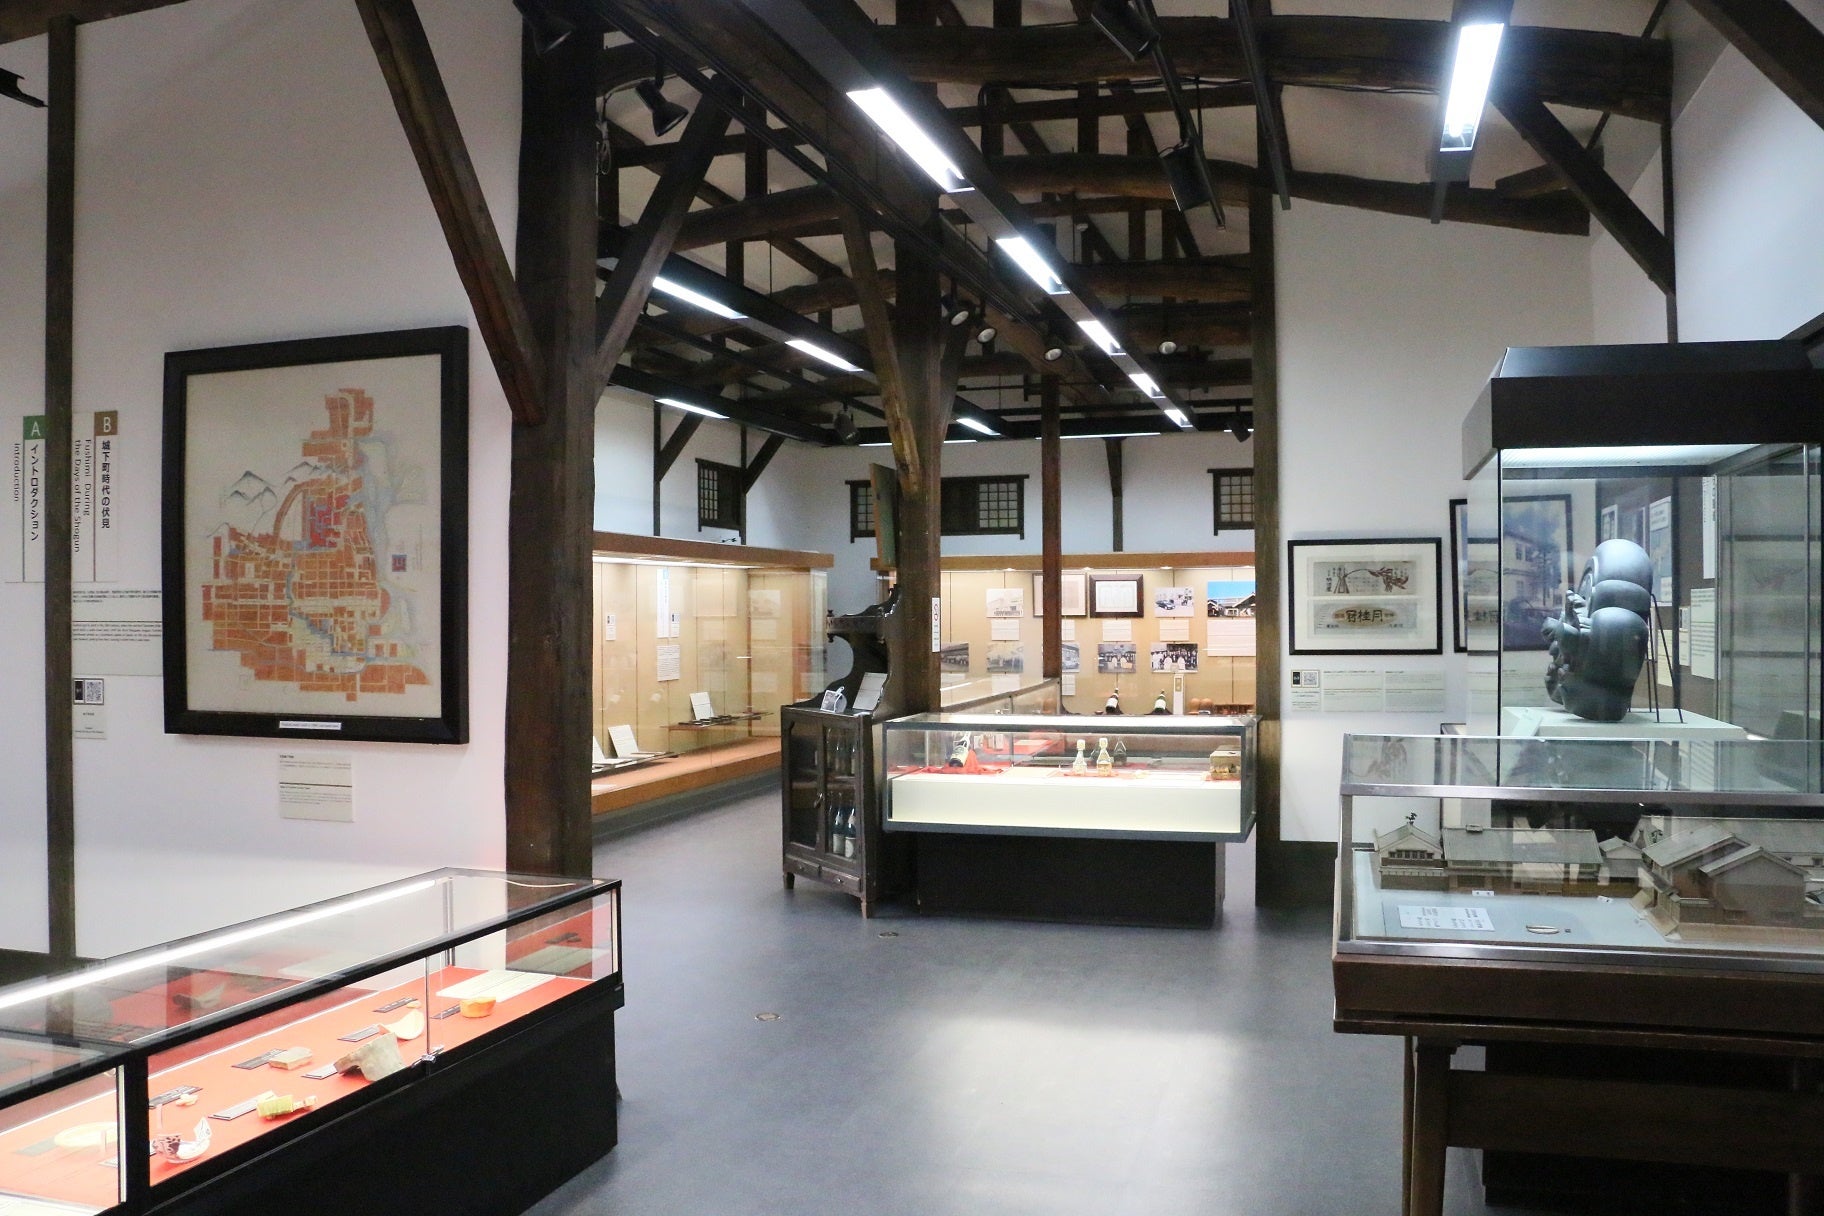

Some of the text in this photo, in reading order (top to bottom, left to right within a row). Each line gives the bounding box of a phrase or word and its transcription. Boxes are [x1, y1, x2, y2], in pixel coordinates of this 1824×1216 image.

[31, 421, 41, 437] A
[103, 416, 112, 433] B
[73, 459, 82, 482] Days
[83, 439, 92, 516] Fushimi During
[101, 439, 111, 529] 城下町時代の伏見
[30, 443, 39, 541] イントロダクション
[75, 484, 81, 494] of
[73, 516, 81, 553] Shogun
